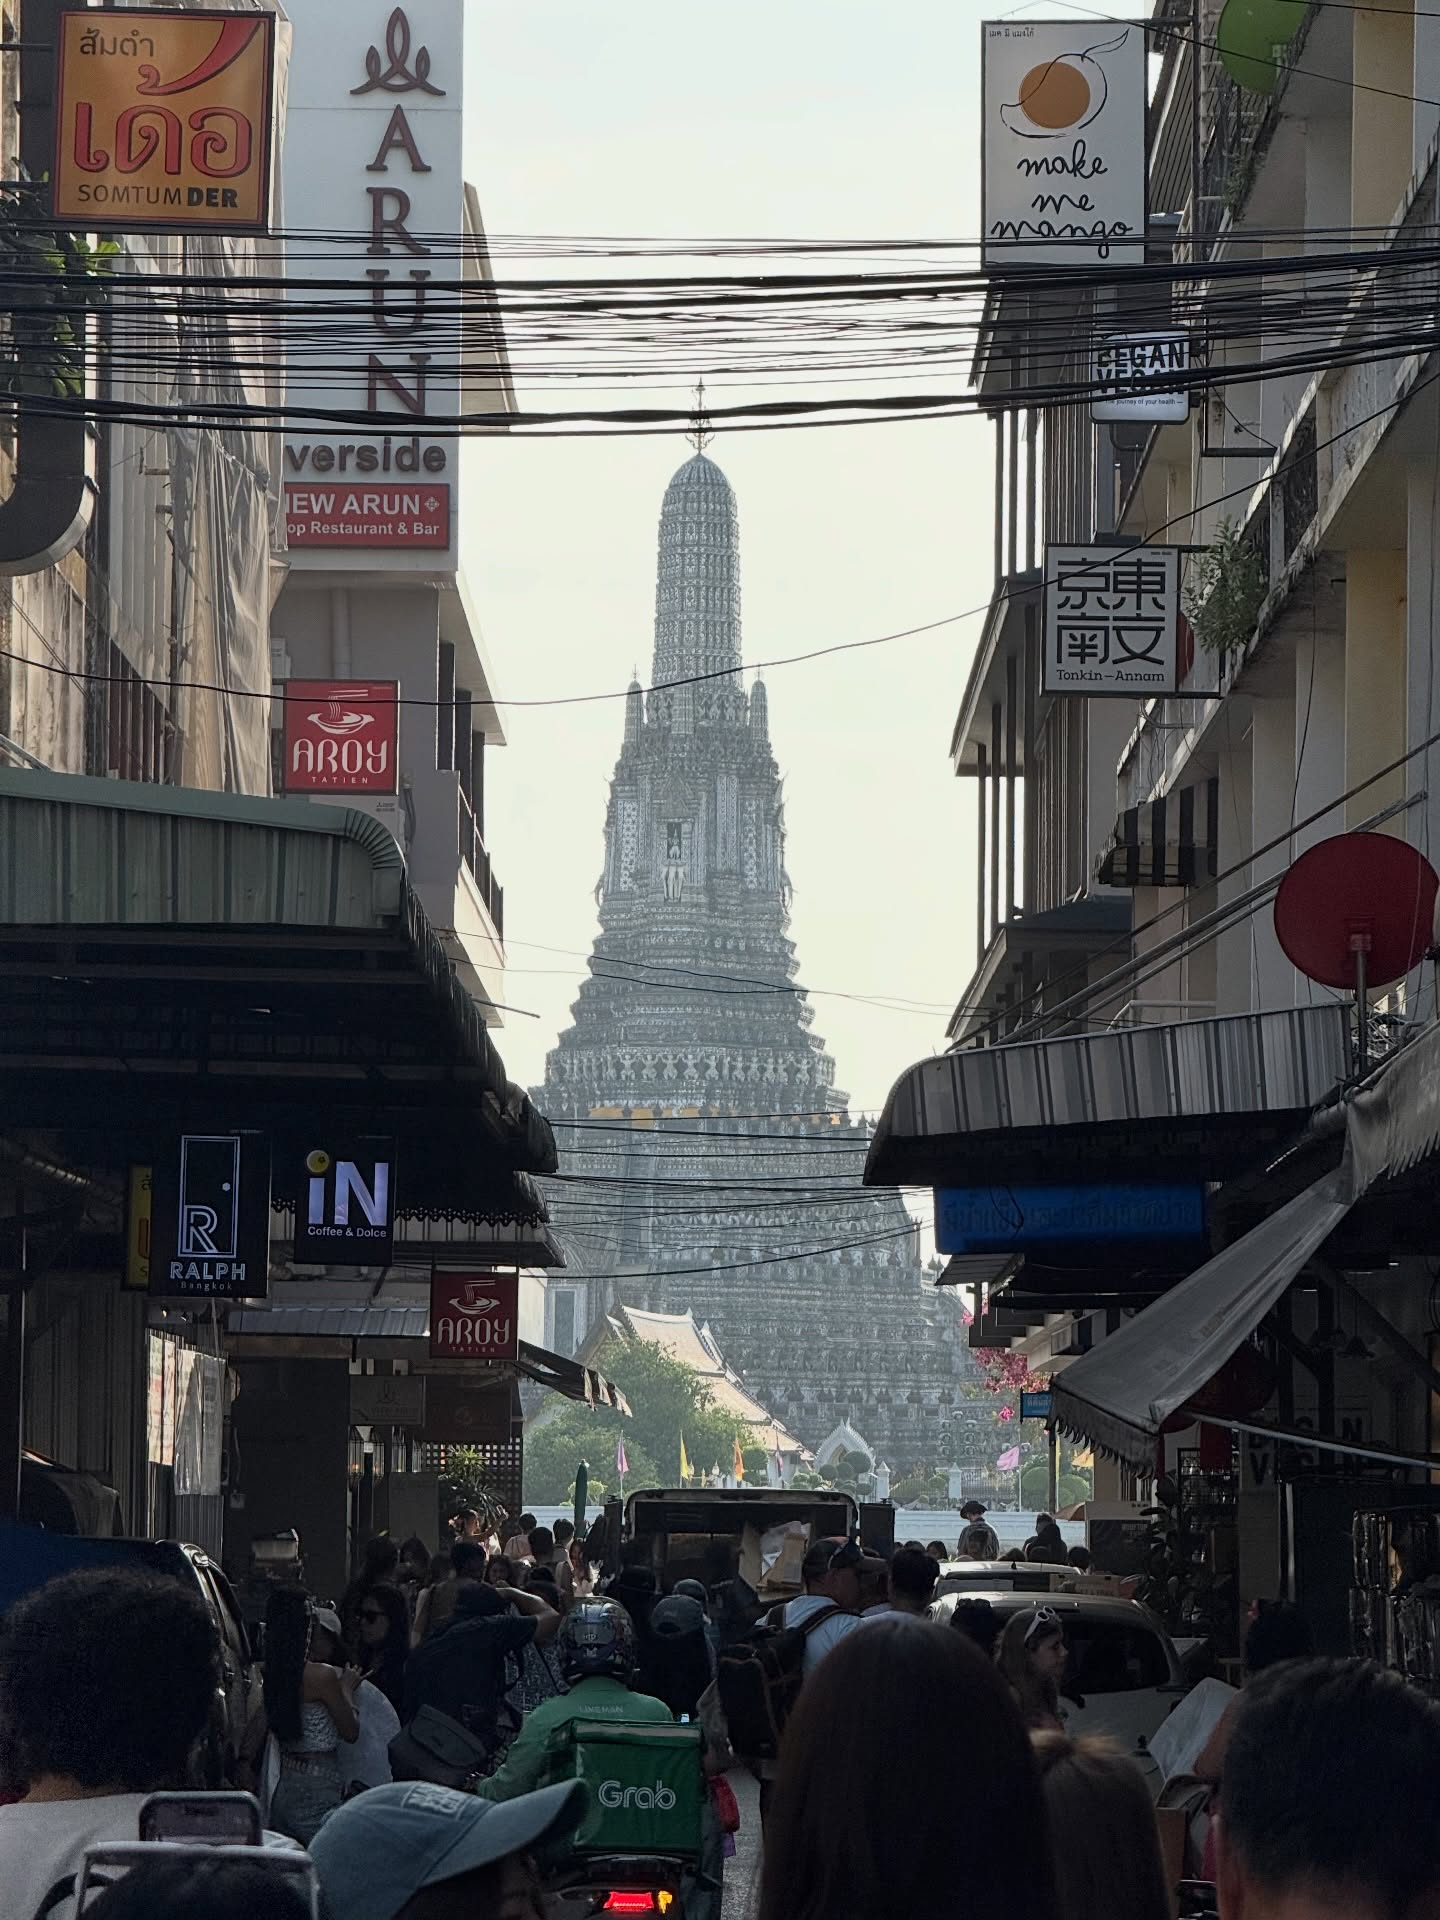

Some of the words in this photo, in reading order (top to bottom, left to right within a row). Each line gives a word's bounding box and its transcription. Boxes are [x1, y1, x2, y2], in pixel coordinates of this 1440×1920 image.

[79, 27, 154, 57] ส้มตำ
[74, 60, 254, 179] เด้อ
[1016, 139, 1108, 179] make
[77, 184, 182, 206] SOMTUM
[187, 187, 238, 208] DER
[1031, 193, 1095, 215] me
[990, 220, 1133, 259] mango
[365, 103, 432, 415] ARUN
[342, 493, 420, 515] ARUN
[310, 521, 393, 535] Restaurant
[398, 522, 408, 535] &
[413, 522, 440, 535] Bar
[292, 738, 388, 774] AROY
[312, 776, 368, 784] TATIEN
[307, 1226, 343, 1236] Coffee
[345, 1227, 354, 1237] &
[356, 1227, 387, 1237] Dolce
[169, 1261, 246, 1281] RALPH
[180, 1281, 233, 1291] Bangkok
[437, 1317, 510, 1345] AROY
[598, 1780, 677, 1810] Grab
